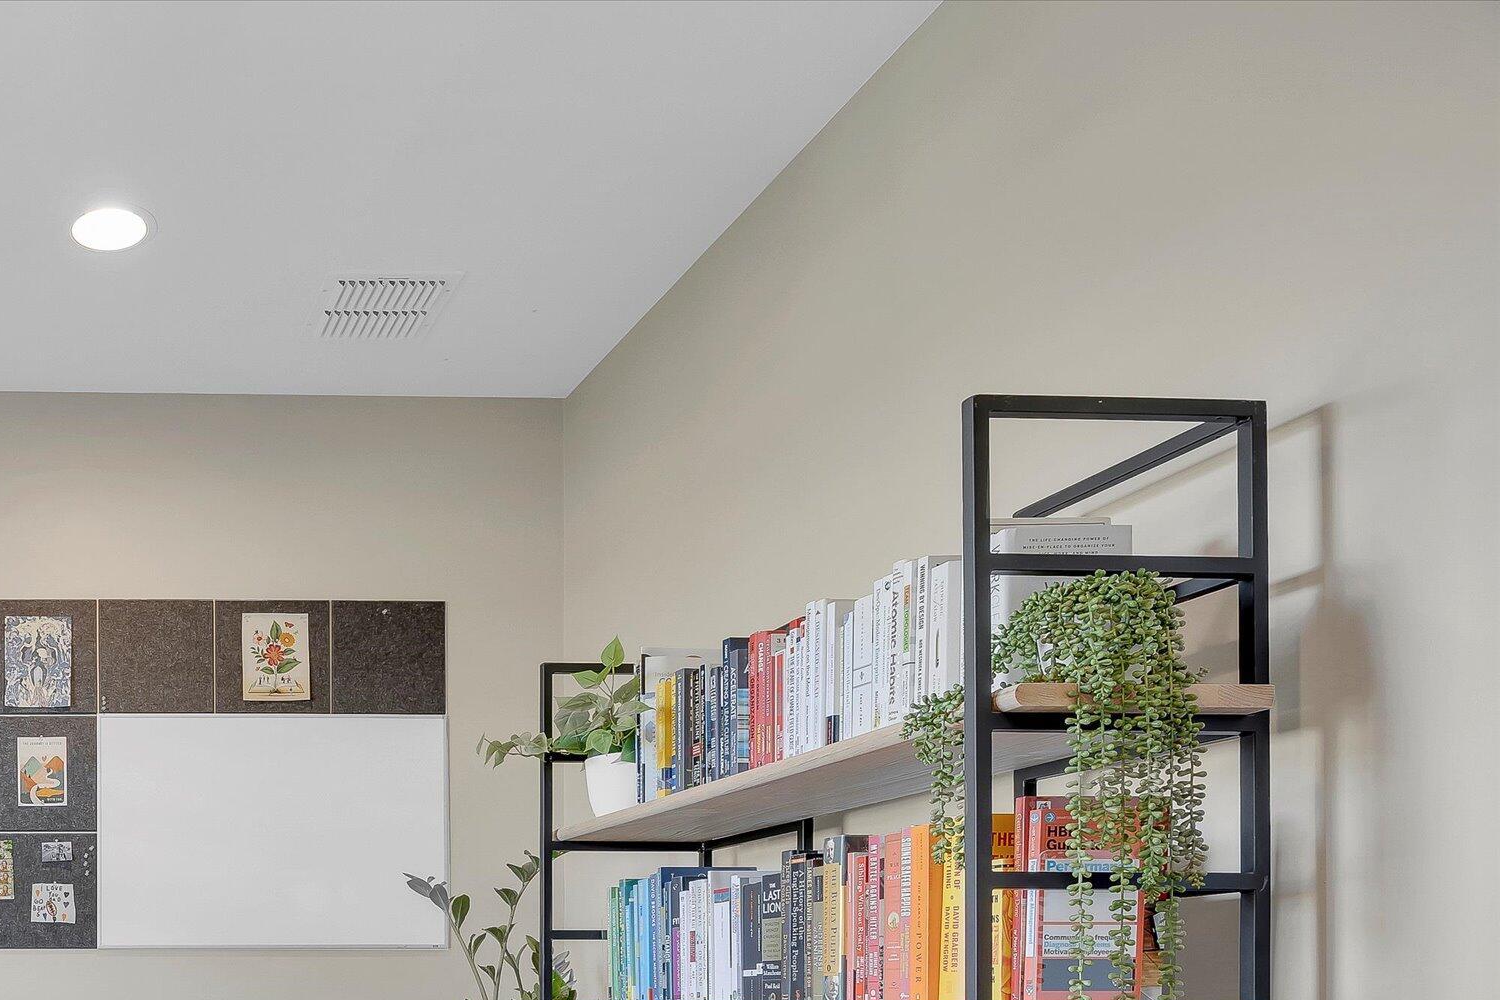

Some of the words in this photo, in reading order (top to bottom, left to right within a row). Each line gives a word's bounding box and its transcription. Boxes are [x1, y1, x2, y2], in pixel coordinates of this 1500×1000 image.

[889, 590, 900, 645] Atomic
[889, 653, 898, 705] Habits
[869, 844, 878, 855] MY
[901, 836, 911, 866] SOONER
[856, 863, 864, 894] Siblings
[869, 856, 878, 883] BATTLE
[901, 866, 911, 888] SAFER
[953, 879, 961, 890] OF
[762, 902, 782, 914] LION
[763, 889, 781, 902] LAST
[791, 870, 799, 948] English-Speaking
[797, 879, 805, 914] History
[830, 890, 838, 924] BULLY
[869, 884, 878, 915] AGAINST
[901, 888, 911, 918] HAPPIER
[869, 916, 877, 940] HITLER
[952, 905, 960, 929] DAVID
[830, 927, 838, 966] PULPIT
[915, 932, 923, 984] POWER
[951, 931, 959, 969] GRAEBER
[791, 949, 799, 982] Peoples
